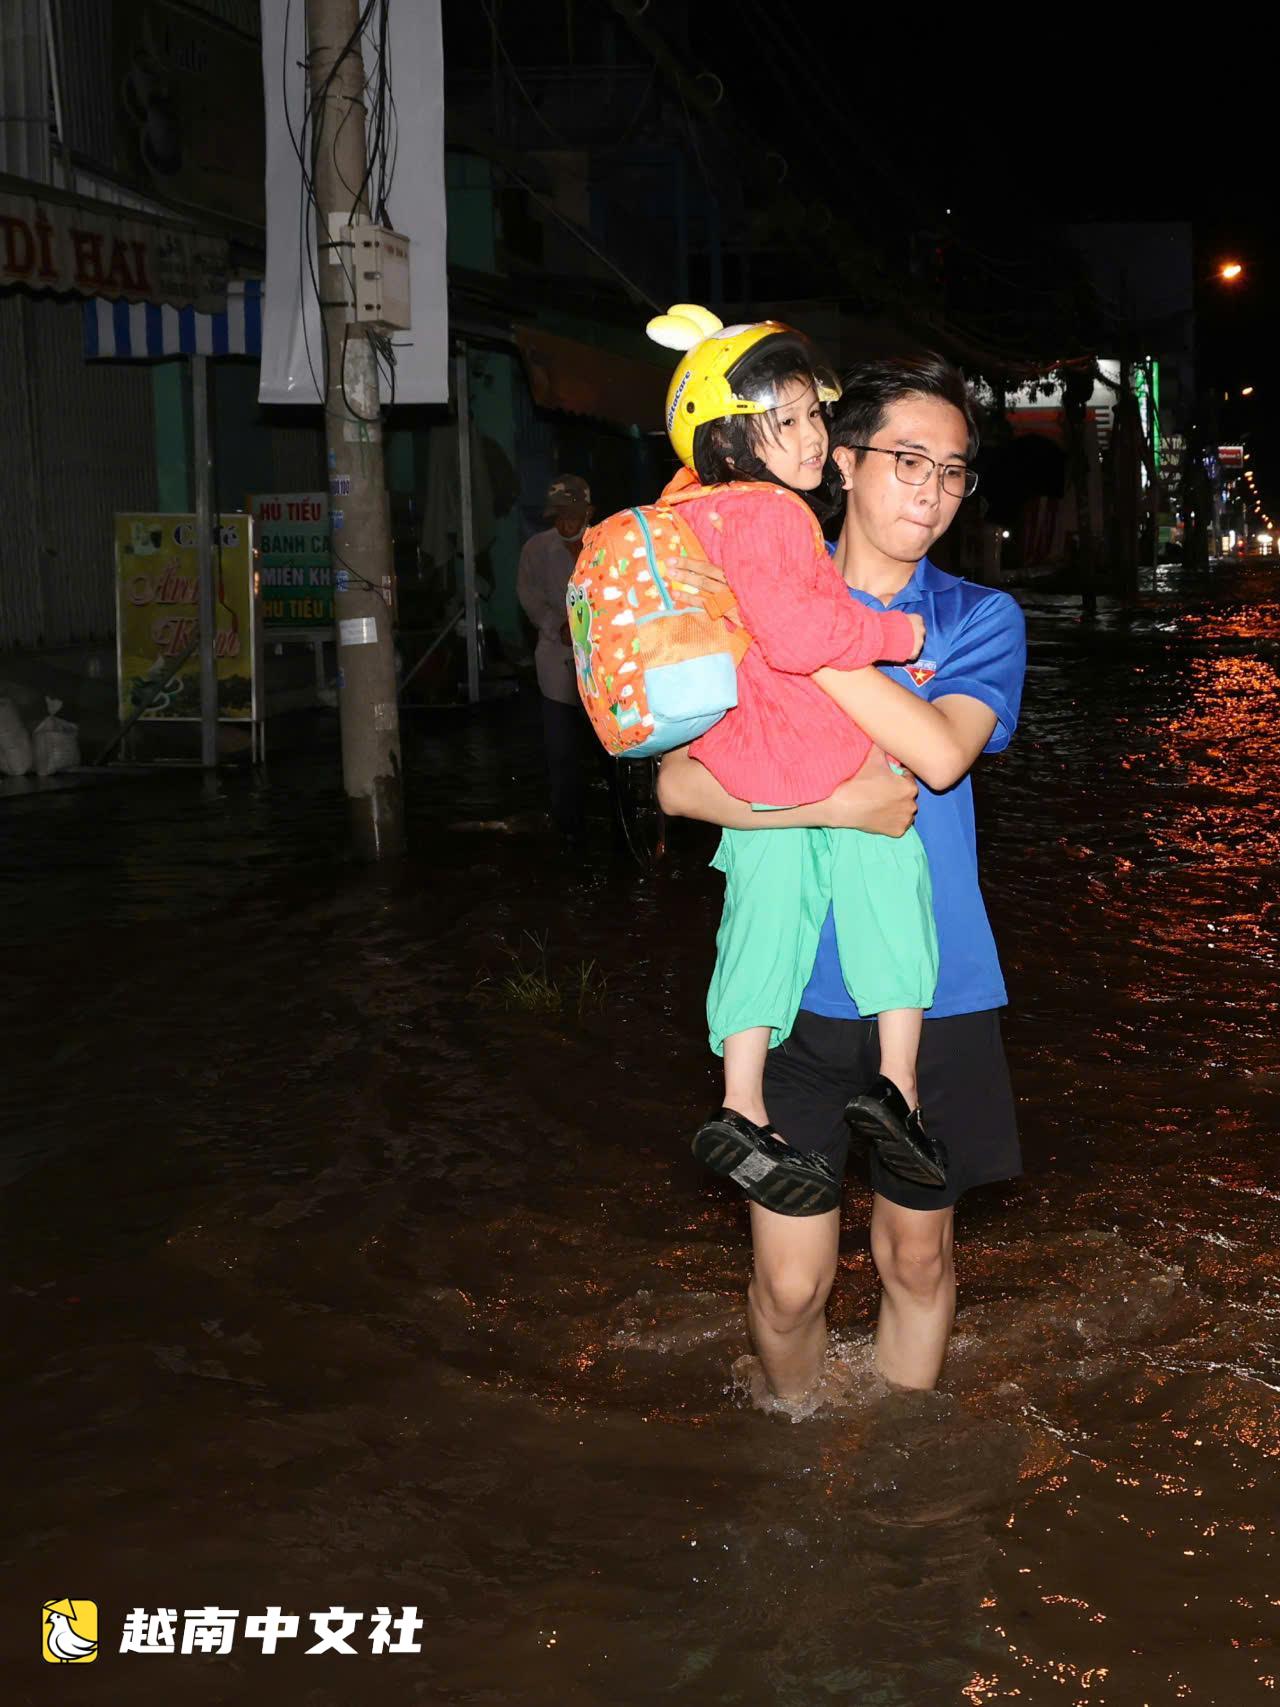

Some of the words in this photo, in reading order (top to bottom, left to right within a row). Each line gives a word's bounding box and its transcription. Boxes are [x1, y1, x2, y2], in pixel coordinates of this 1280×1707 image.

[69, 227, 151, 290] HAI
[260, 497, 281, 520] HỦ
[288, 496, 321, 520] TIẾU
[172, 523, 239, 546] Cfé
